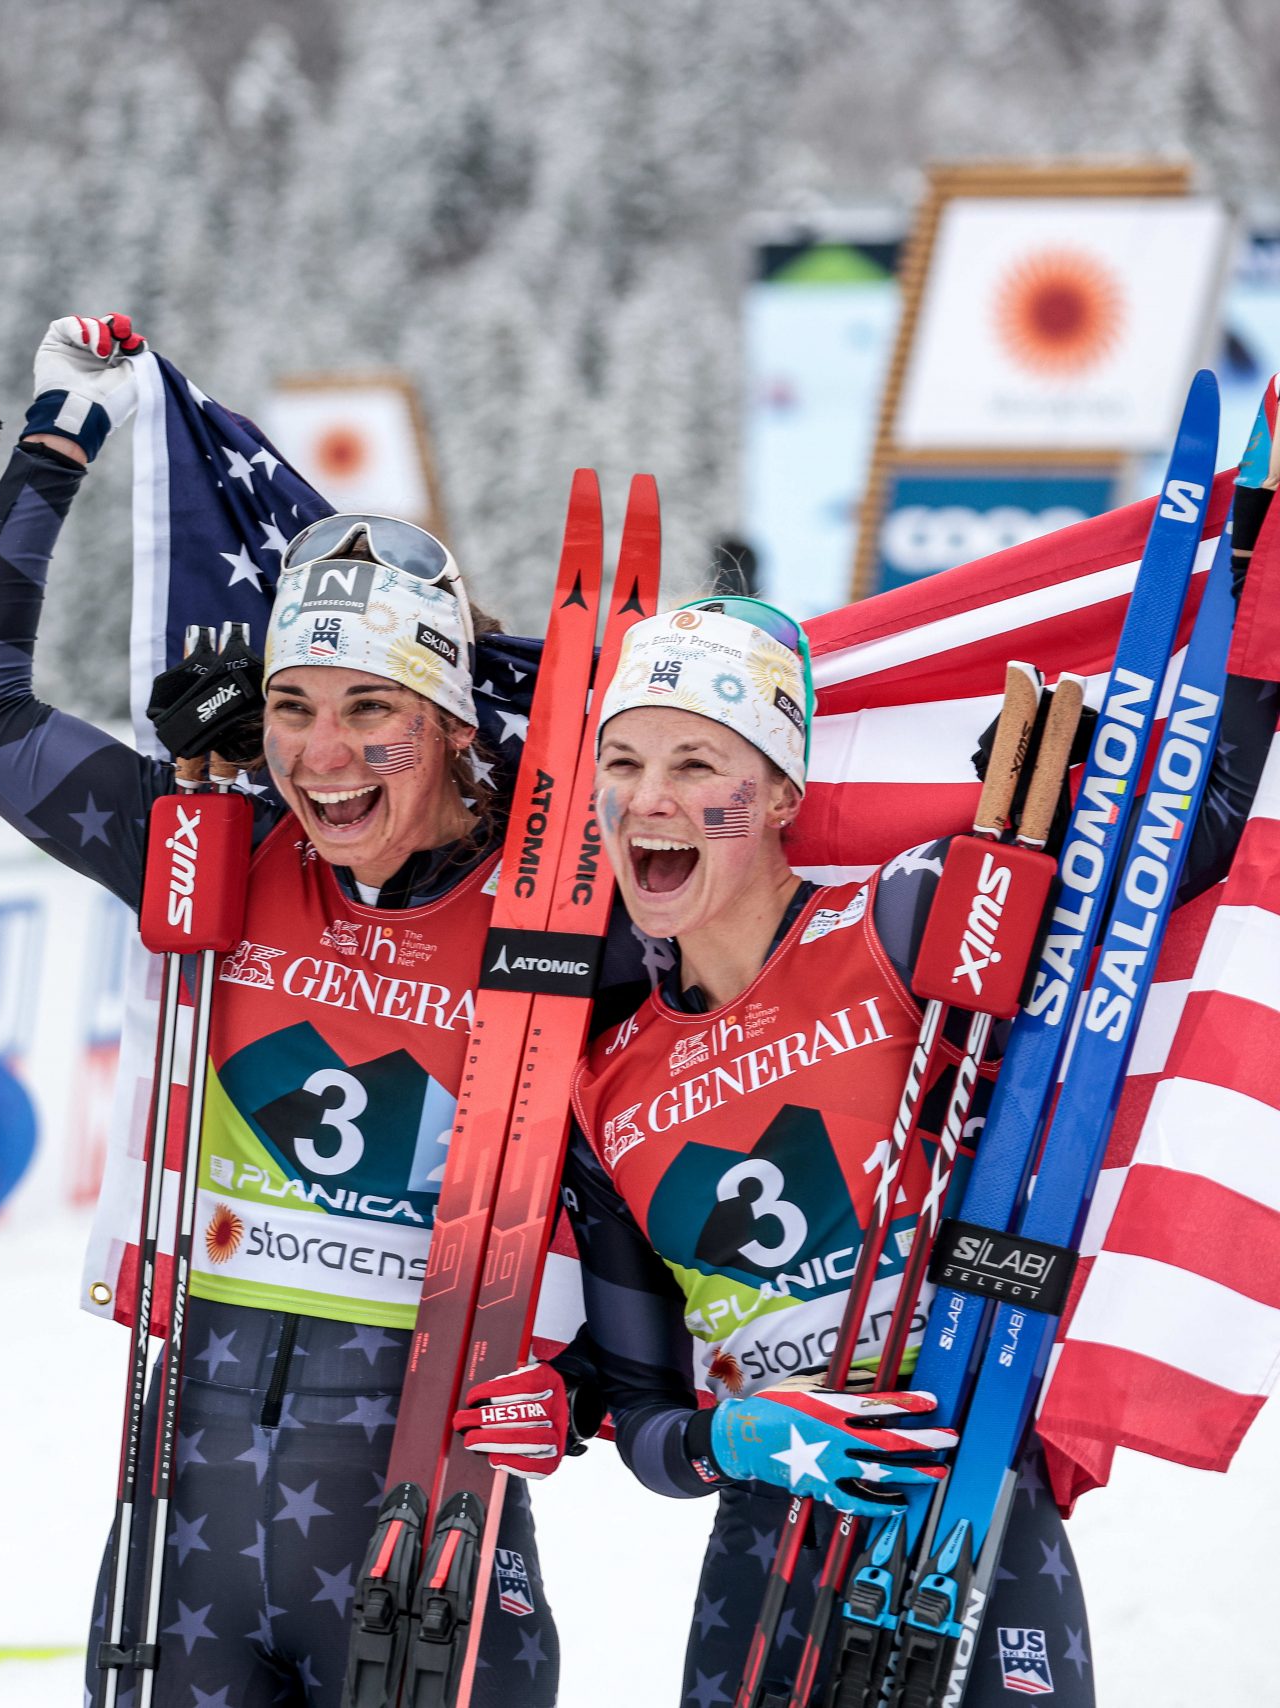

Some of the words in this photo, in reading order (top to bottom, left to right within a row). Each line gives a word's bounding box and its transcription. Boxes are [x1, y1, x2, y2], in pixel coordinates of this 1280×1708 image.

[302, 599, 365, 608] NEVERSECOND
[314, 617, 342, 631] US
[420, 630, 456, 661] SKIDA
[651, 633, 686, 646] Emily
[690, 635, 743, 659] Program
[192, 663, 209, 675] TC
[225, 658, 249, 671] TCS
[654, 660, 683, 673] US
[514, 769, 555, 899] ATOMIC
[1024, 668, 1154, 1026] SALOMON
[1086, 684, 1220, 1042] SALOMON
[403, 929, 423, 941] The
[399, 947, 432, 962] Safety
[401, 940, 438, 953] Human
[397, 957, 416, 968] Net
[511, 957, 590, 976] ATOMIC
[282, 956, 477, 1034] GENERA
[744, 1006, 780, 1021] Human
[745, 1002, 763, 1013] The
[744, 1015, 777, 1030] Safety
[745, 1027, 765, 1040] Net
[648, 997, 893, 1133] GENERALI
[670, 1052, 710, 1077] GENERALI
[455, 1021, 485, 1134] REDSTER
[512, 1028, 542, 1142] REDSTER
[293, 1068, 368, 1176] 3
[237, 1163, 424, 1223] PLANICA
[717, 1158, 808, 1268] 3
[247, 1222, 427, 1281] storaens
[944, 1268, 1039, 1299] SELECT
[481, 1402, 547, 1423] HESTRA
[495, 1550, 526, 1573] US
[498, 1569, 511, 1578] SKI
[1001, 1629, 1044, 1651] US
[1003, 1650, 1019, 1658] SKI
[1022, 1651, 1046, 1660] TEAM
